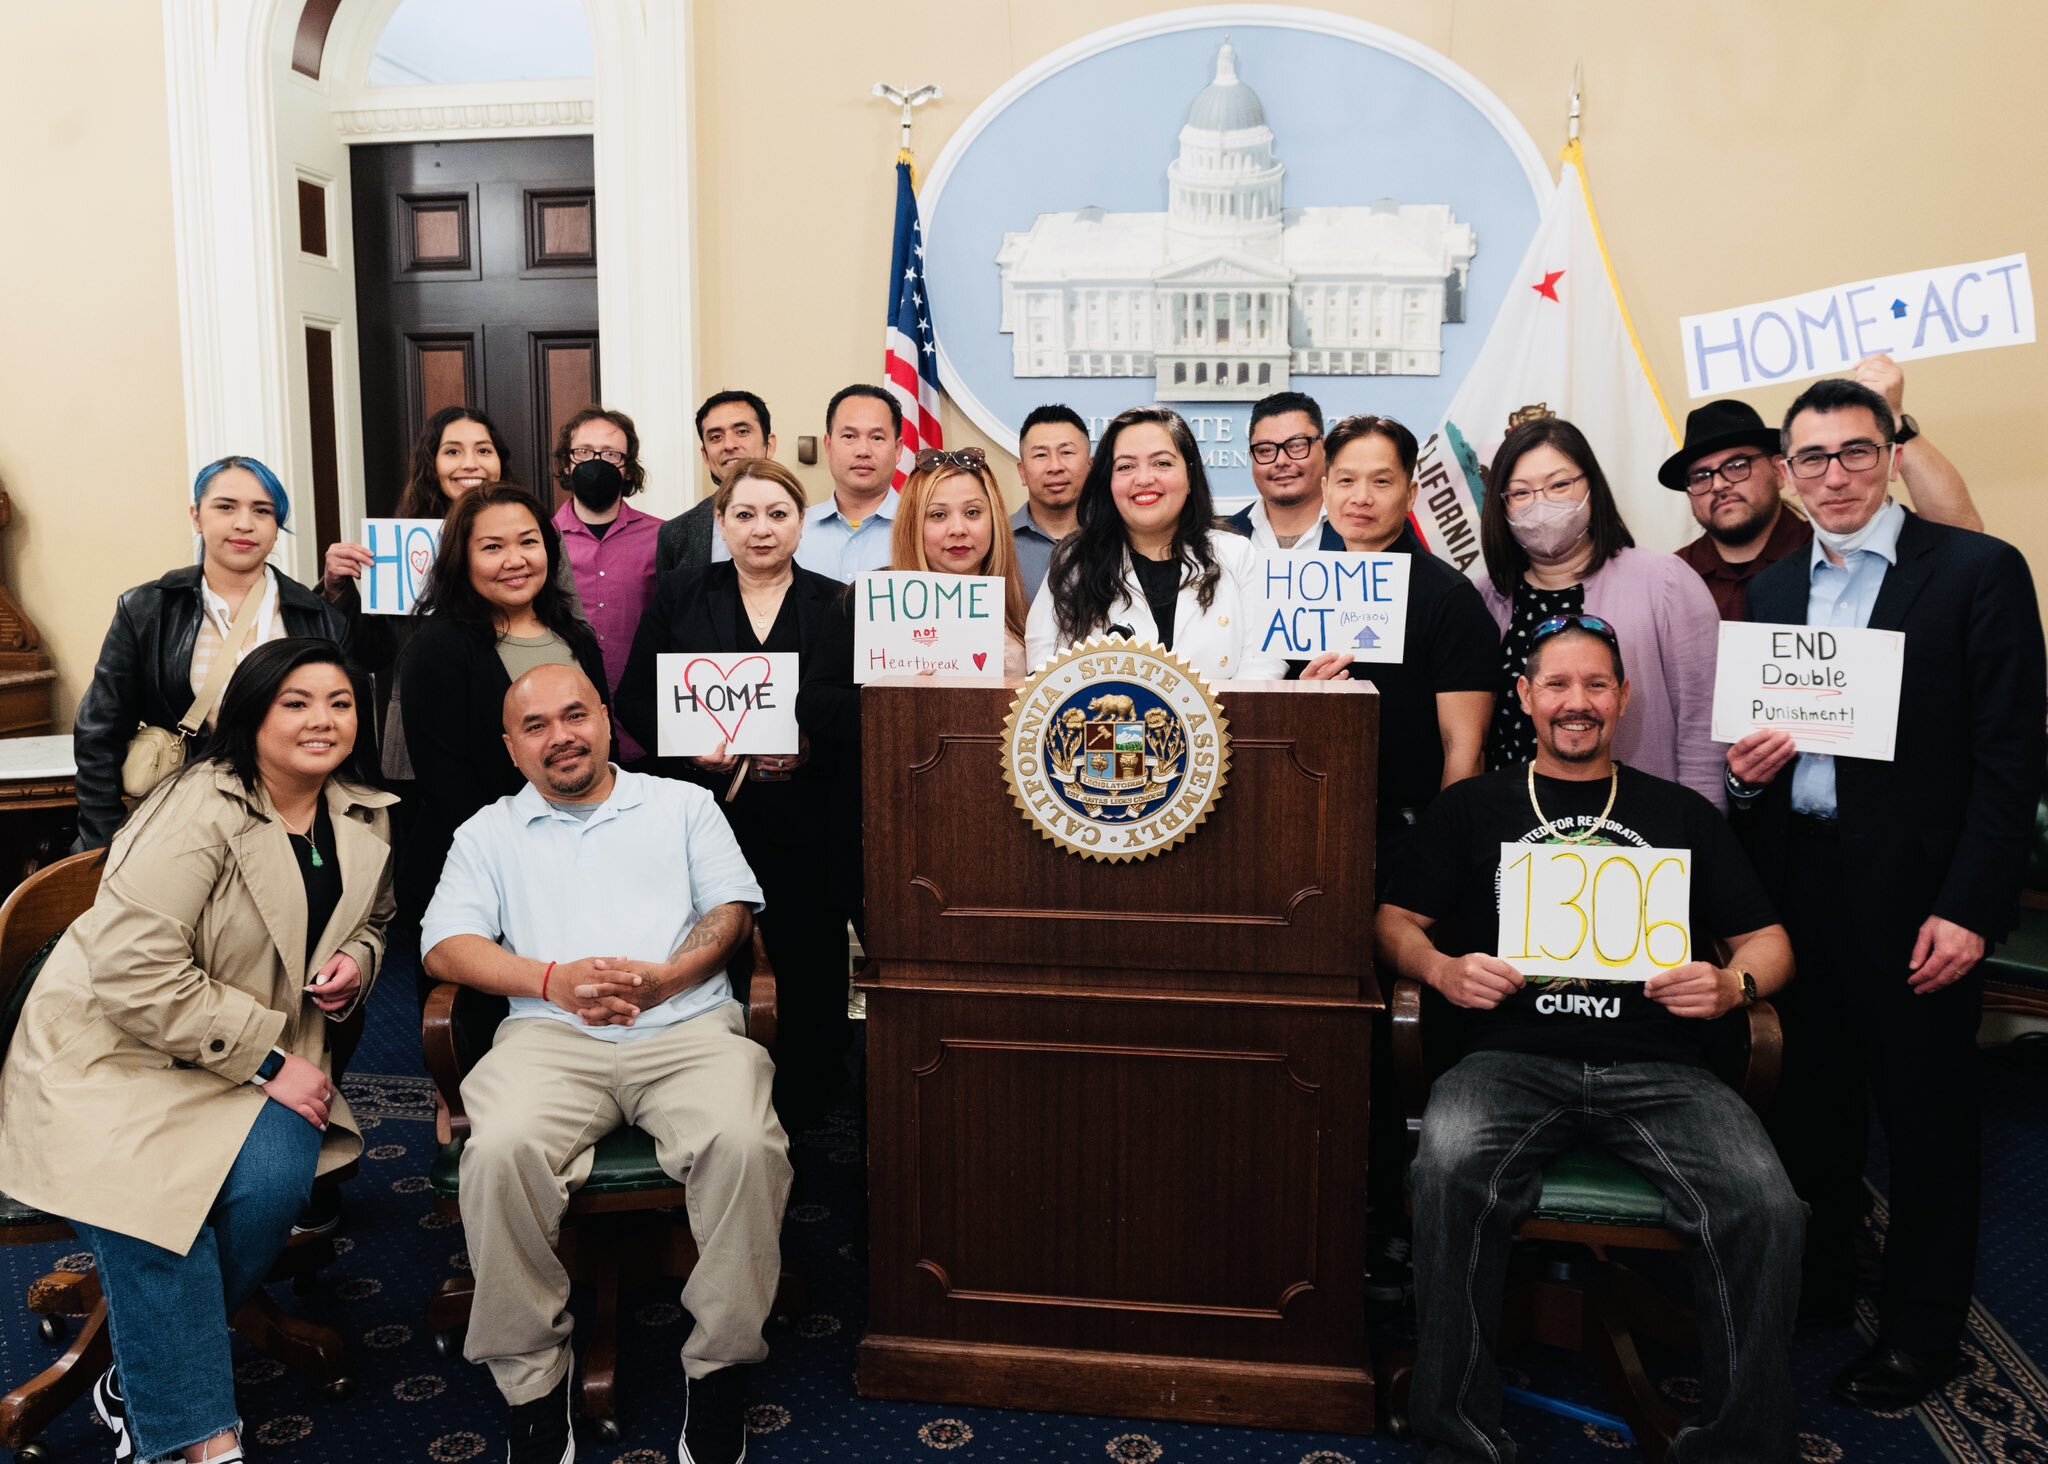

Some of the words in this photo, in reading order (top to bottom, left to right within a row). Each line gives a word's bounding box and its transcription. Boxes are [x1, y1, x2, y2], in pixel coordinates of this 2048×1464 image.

[1693, 285, 1894, 391] HOME
[1911, 263, 2023, 349] ACT
[1266, 559, 1394, 602] HOME
[867, 578, 989, 622] HOME
[913, 627, 937, 638] not
[1261, 607, 1335, 652] ACT
[1772, 631, 1837, 660] END
[870, 648, 960, 670] Heartbreak
[1078, 656, 1182, 695] STATE
[1762, 663, 1847, 687] Double
[674, 683, 777, 713] HOME
[1752, 699, 1854, 724] Punishment!
[1017, 684, 1102, 846] CALIFORNIA
[1122, 711, 1215, 848] ASSEMBLY
[1549, 816, 1575, 830] FOR
[1506, 851, 1689, 969] 1306
[1535, 994, 1621, 1019] CURYJ
